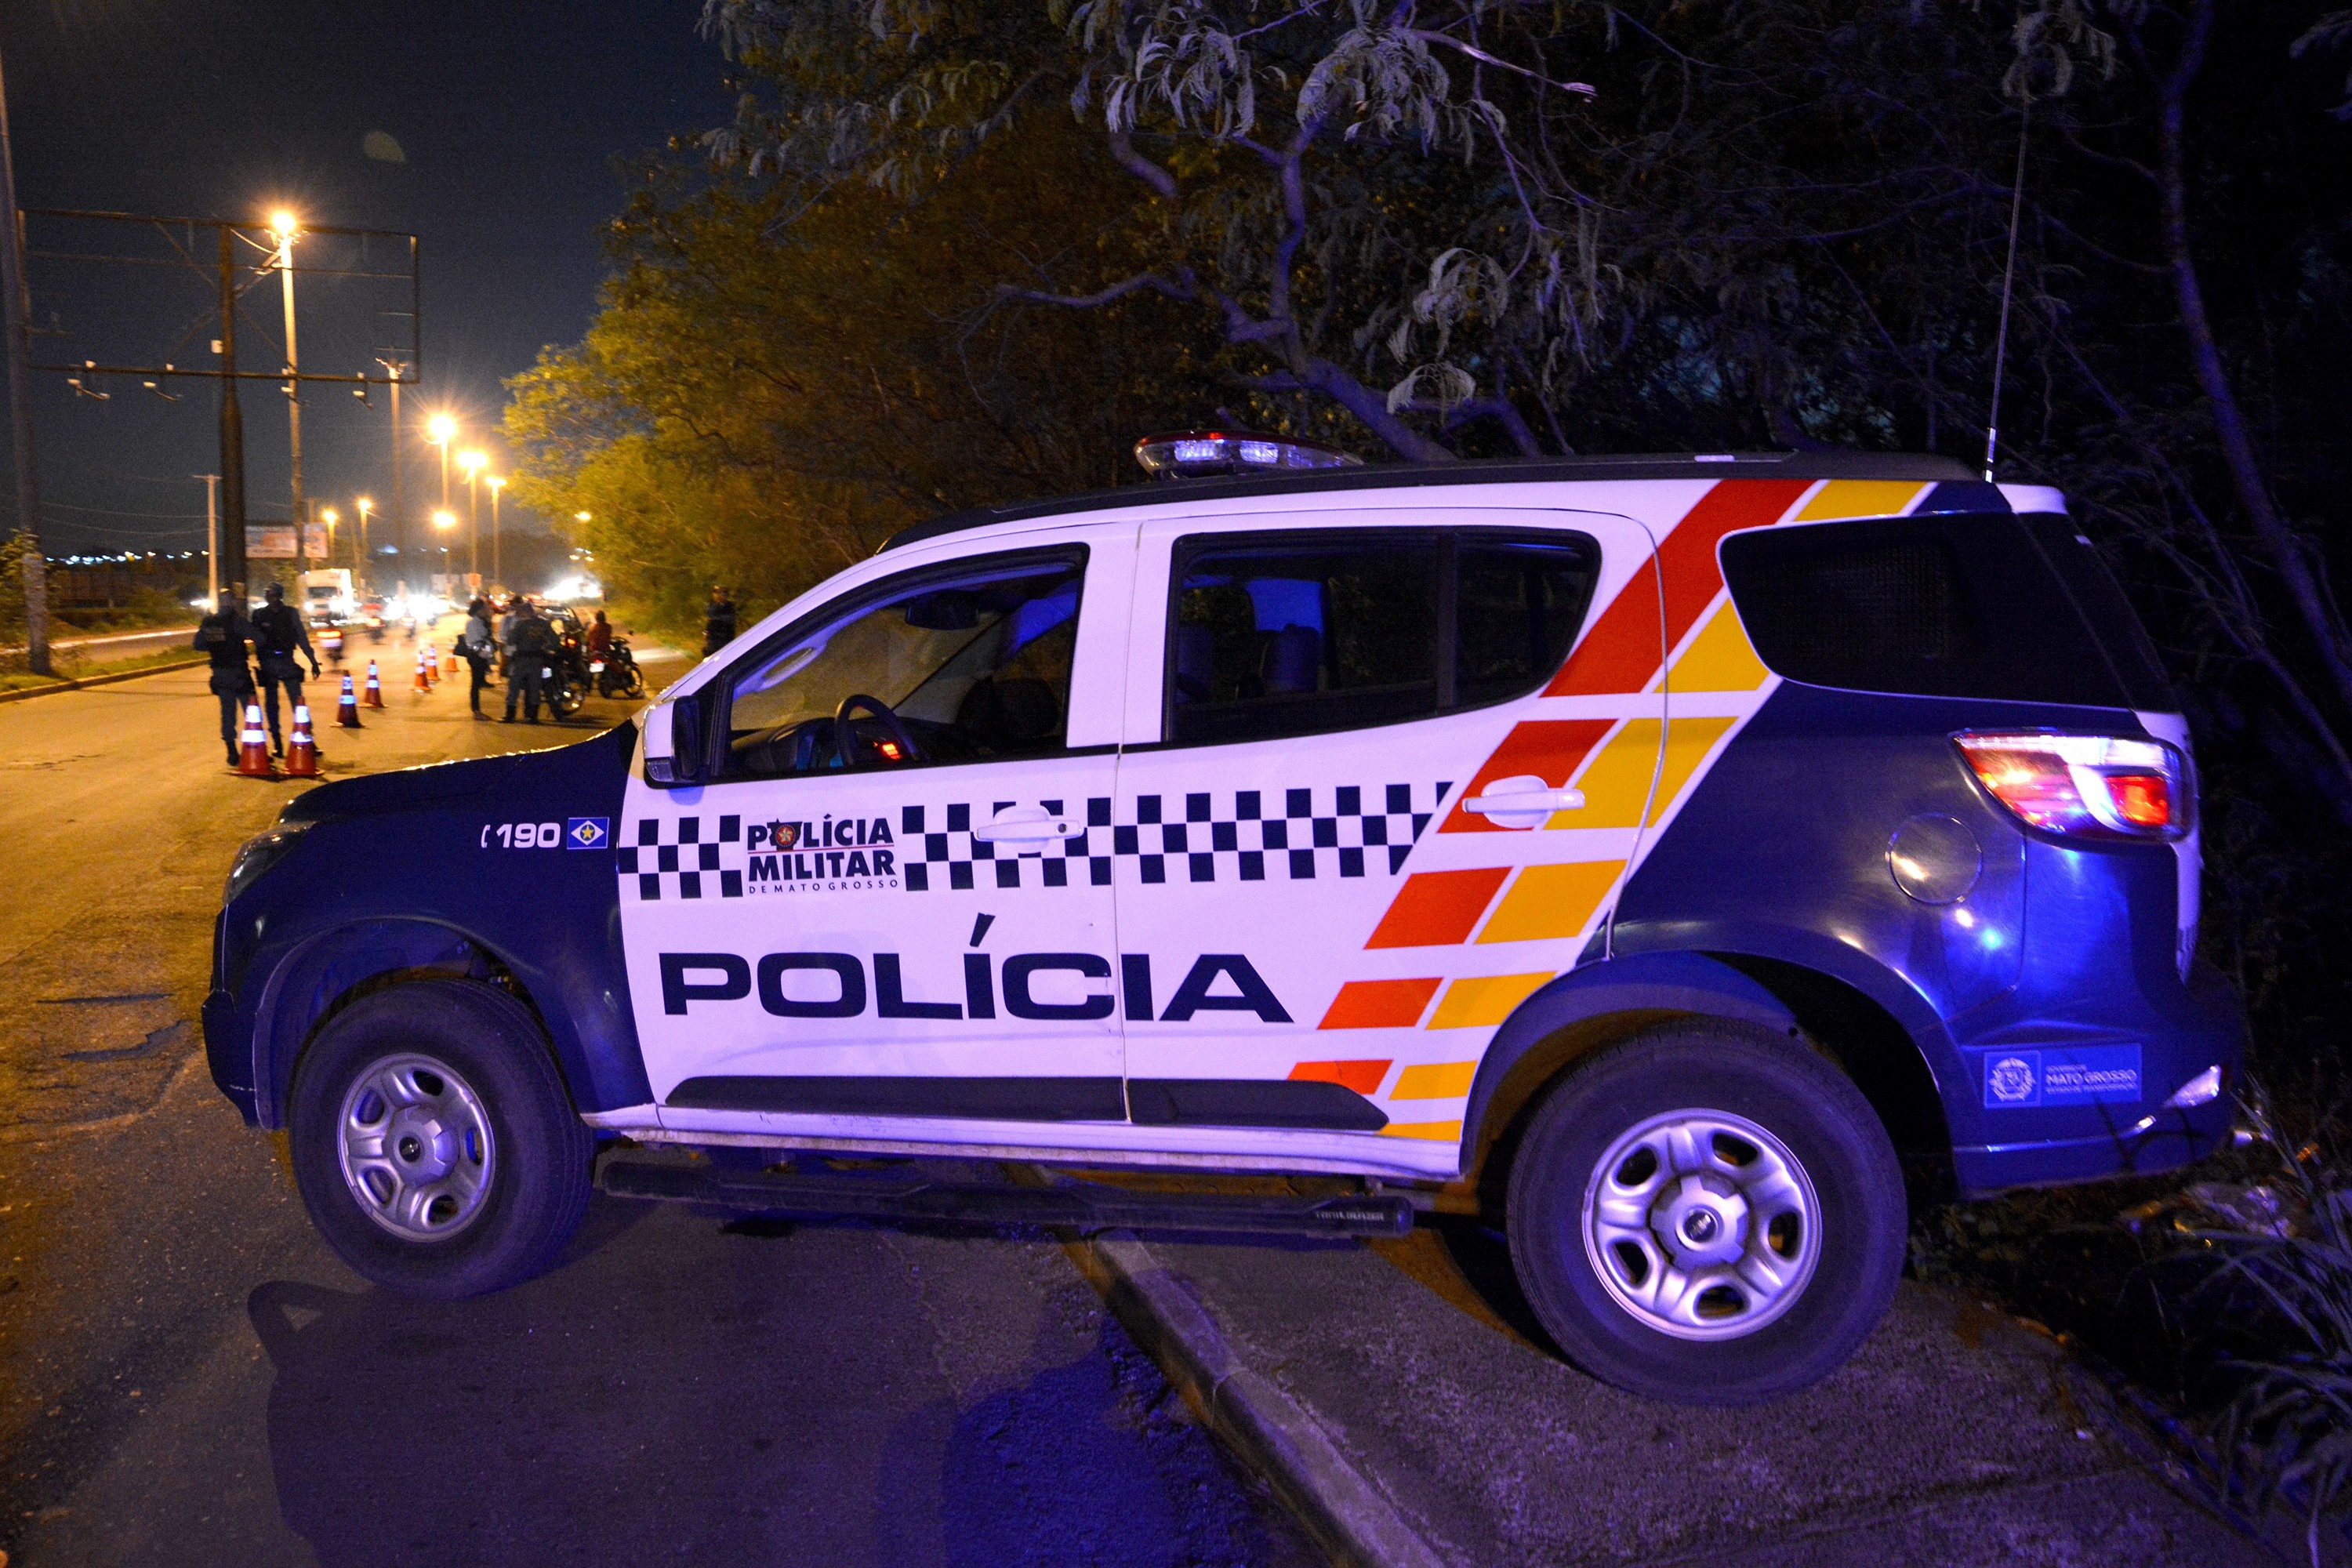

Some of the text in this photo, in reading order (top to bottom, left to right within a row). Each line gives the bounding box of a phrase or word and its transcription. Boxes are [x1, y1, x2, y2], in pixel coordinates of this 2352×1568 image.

[496, 822, 561, 848] 190
[749, 850, 896, 881] MILITAR
[749, 879, 898, 894] DE MATO GROSSO
[659, 913, 1296, 1023] POLÍCIA
[2045, 1069, 2137, 1086] MATO GROSSO
